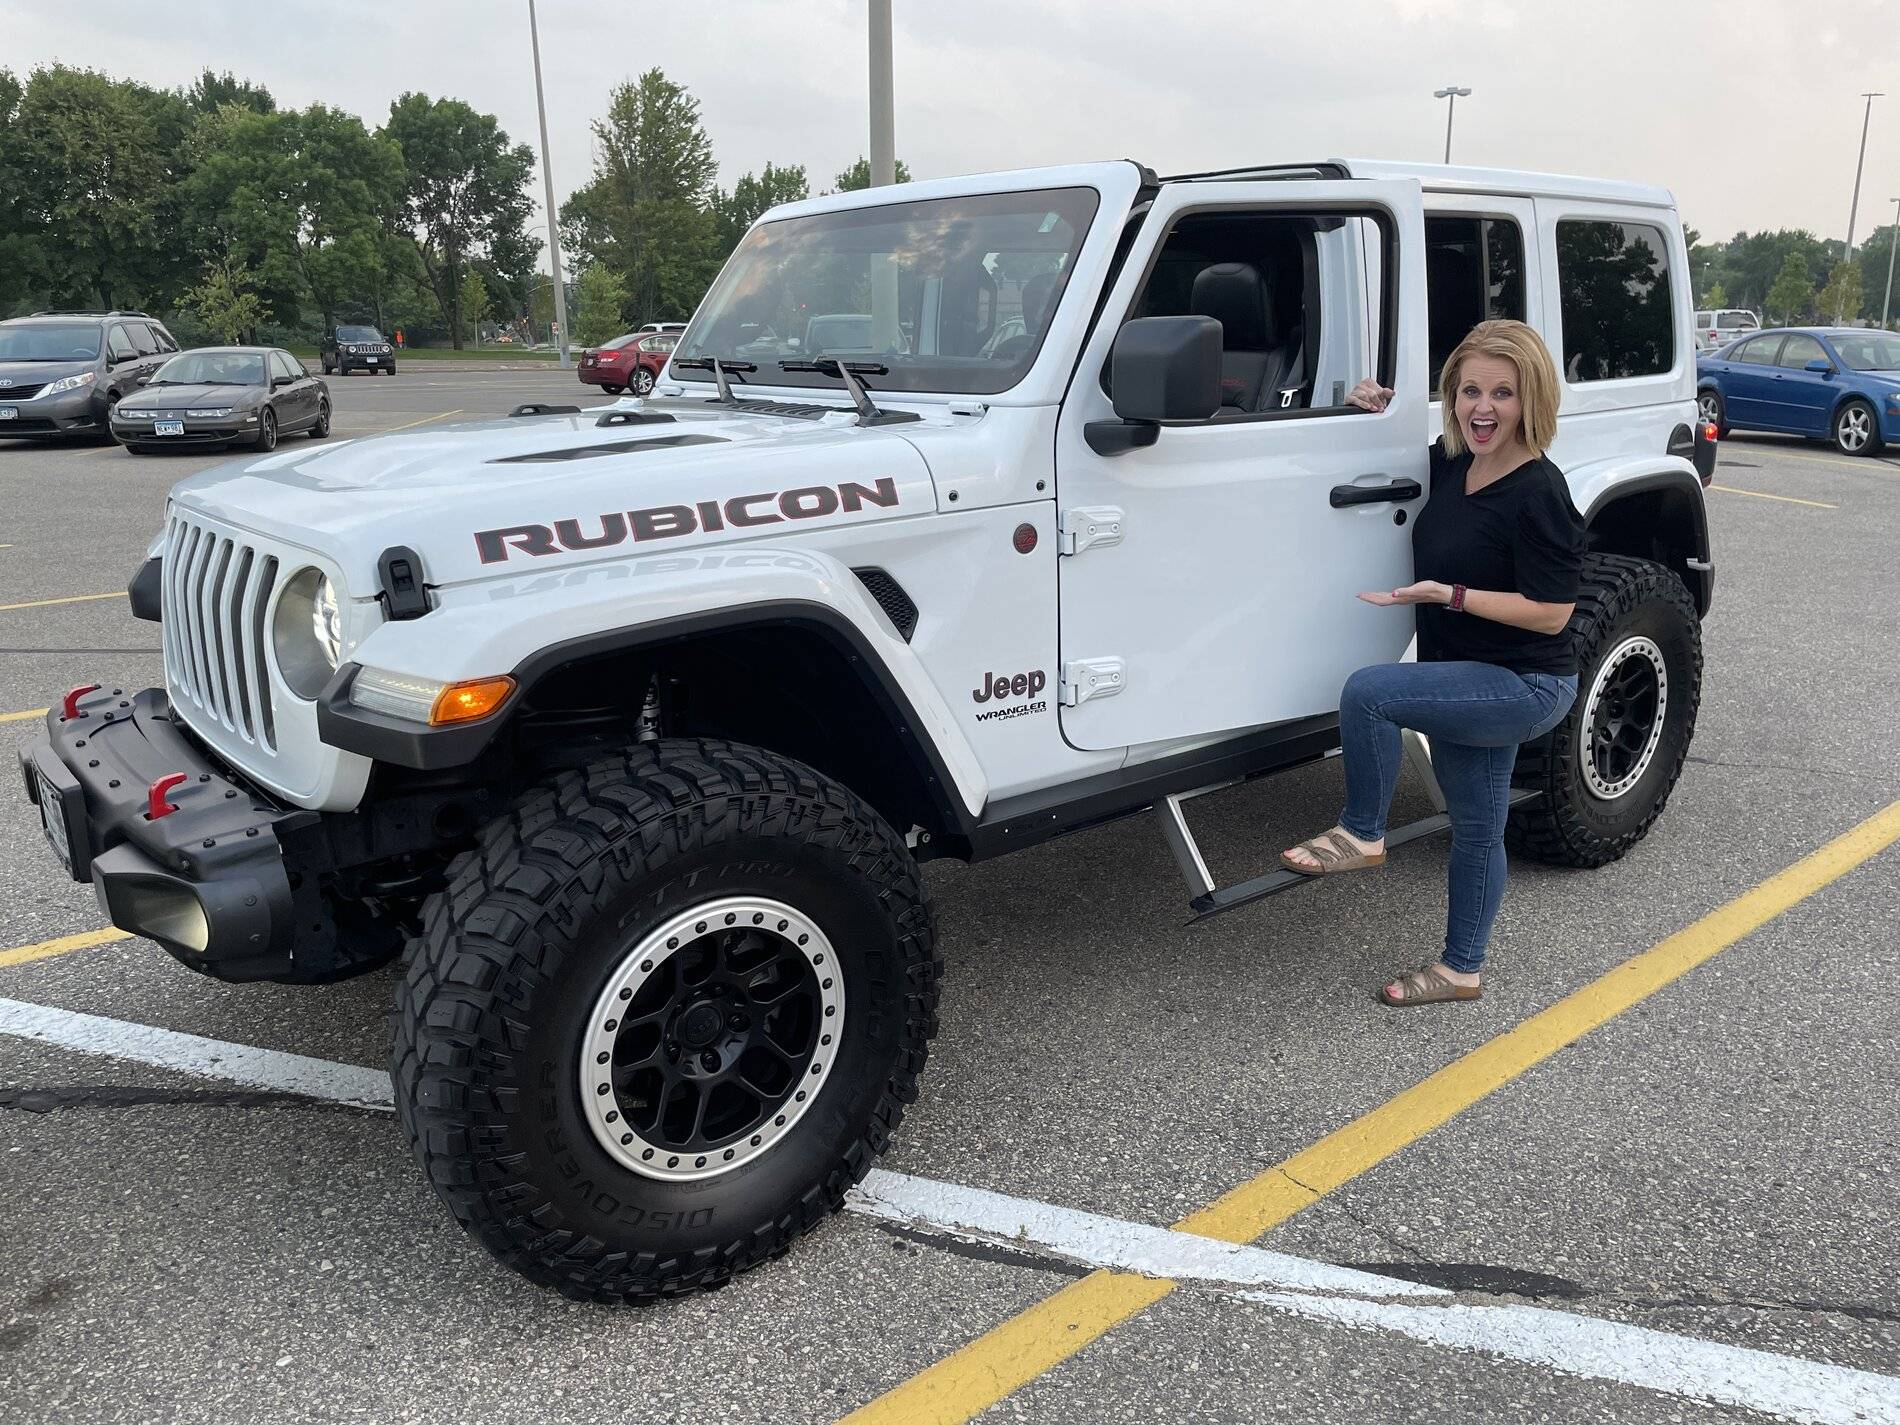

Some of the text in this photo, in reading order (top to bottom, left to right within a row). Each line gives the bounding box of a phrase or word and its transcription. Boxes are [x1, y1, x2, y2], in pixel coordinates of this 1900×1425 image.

[474, 476, 899, 564] RUBICON
[973, 670, 1045, 703] Jeep
[976, 701, 1047, 721] WRANGLER
[998, 707, 1047, 721] UNLIMITED
[542, 1058, 716, 1232] DISCOVERER
